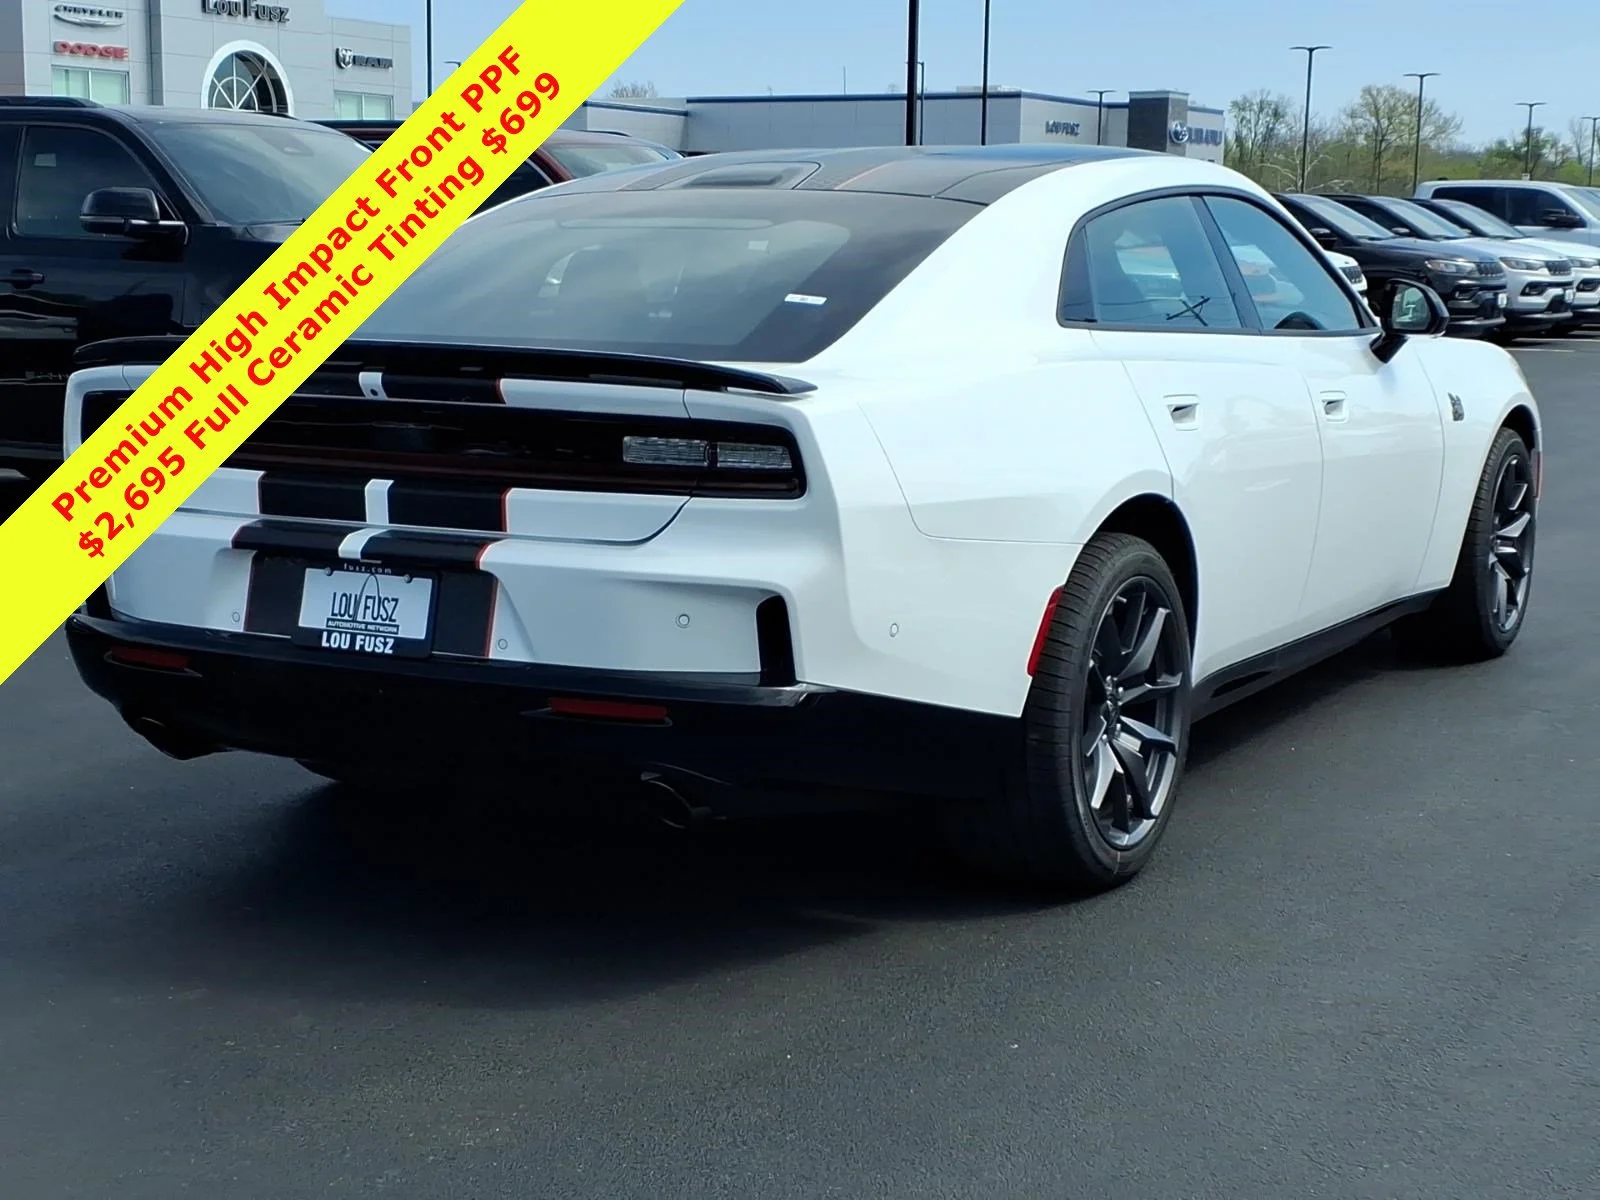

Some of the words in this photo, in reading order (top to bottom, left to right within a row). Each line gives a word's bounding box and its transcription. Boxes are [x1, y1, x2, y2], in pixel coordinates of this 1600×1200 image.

[54, 5, 124, 19] CHRYSLER
[201, 0, 241, 16] Lou
[243, 0, 290, 23] Fusz
[54, 41, 128, 60] DODGE
[352, 55, 392, 69] RAM
[330, 591, 358, 619] LOU
[362, 596, 399, 622] FUSZ
[327, 620, 366, 630] AUTOMOTIVE
[367, 625, 398, 634] NETWORK
[321, 631, 351, 649] LOU
[355, 634, 395, 655] FUSZ
